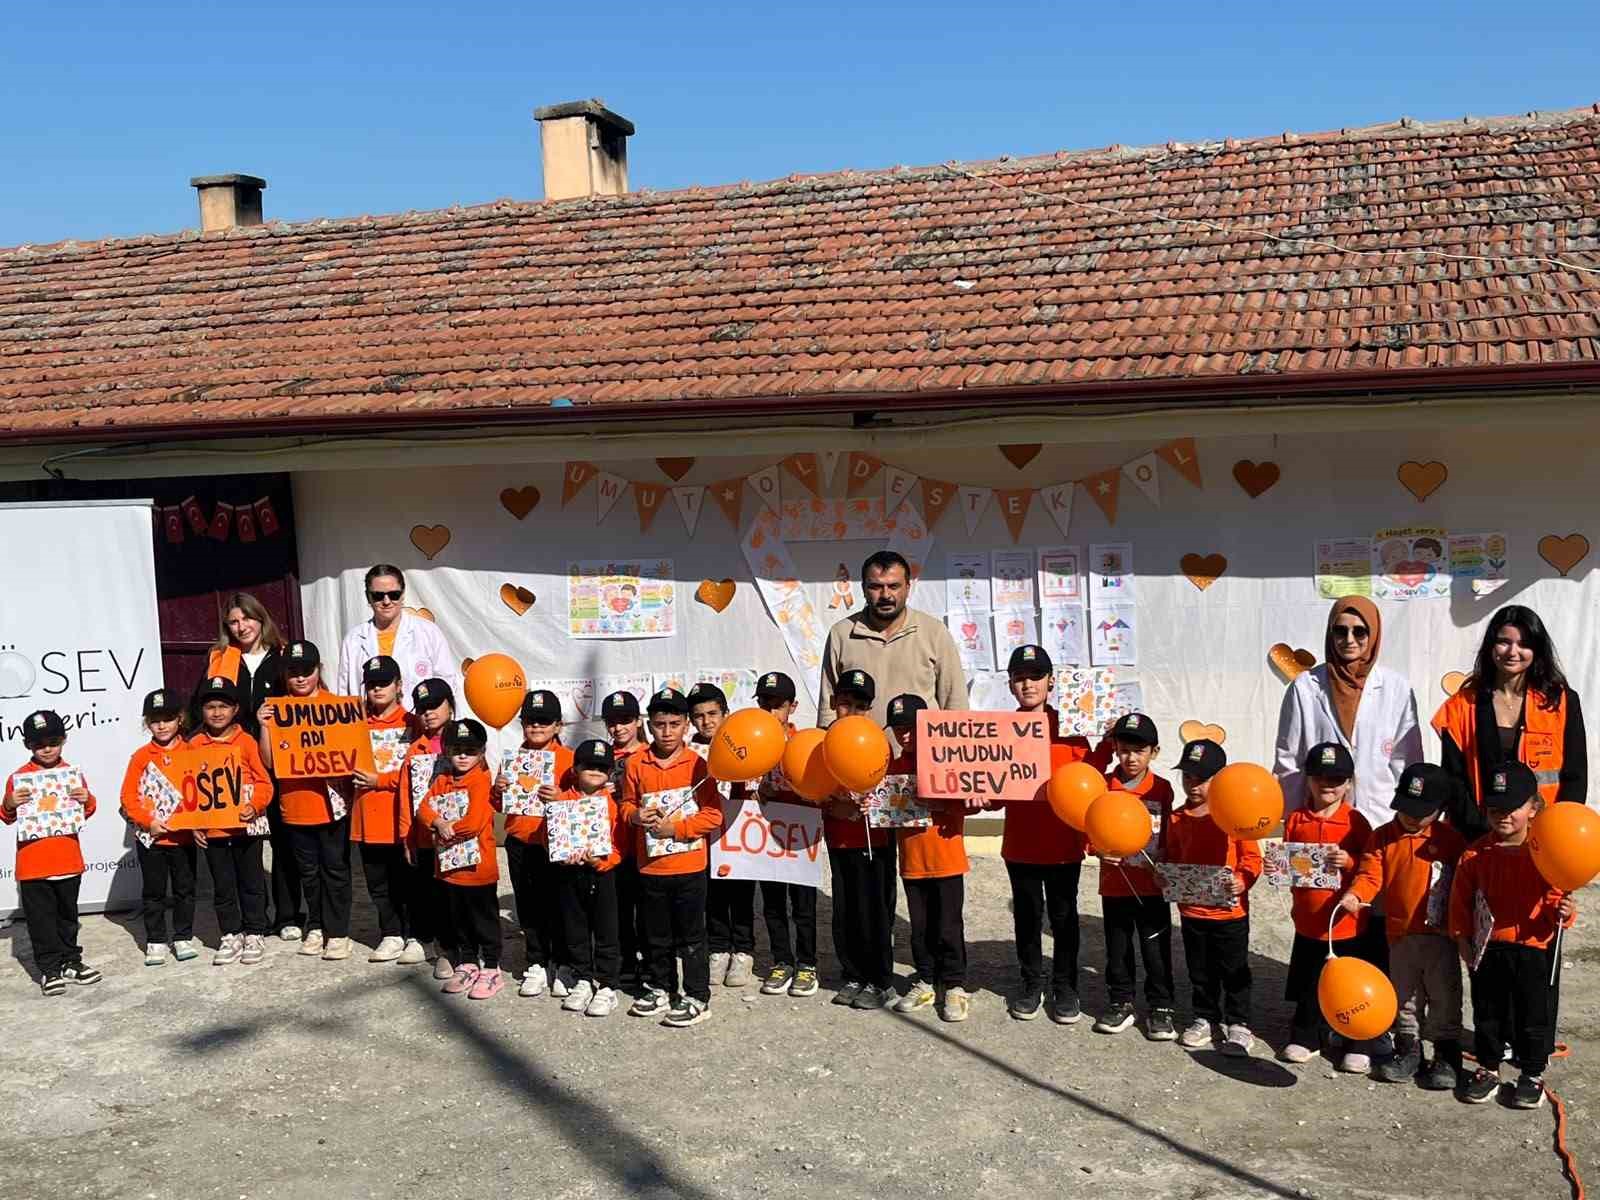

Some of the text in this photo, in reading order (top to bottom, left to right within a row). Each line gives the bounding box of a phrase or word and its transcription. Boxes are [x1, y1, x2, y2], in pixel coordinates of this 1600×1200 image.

[570, 464, 694, 511] UMUT
[853, 460, 1067, 514] DESTEK
[273, 702, 364, 728] UMUDUN
[927, 718, 1044, 738] MUCİZE VE
[301, 730, 325, 748] ADI
[290, 748, 357, 775] LÖSEV
[931, 744, 1013, 763] UMUDUN
[930, 768, 1007, 794] LÖSEV
[1010, 762, 1037, 780] ADI
[176, 765, 241, 813] ÖSEV
[720, 811, 821, 862] LÖSEV
